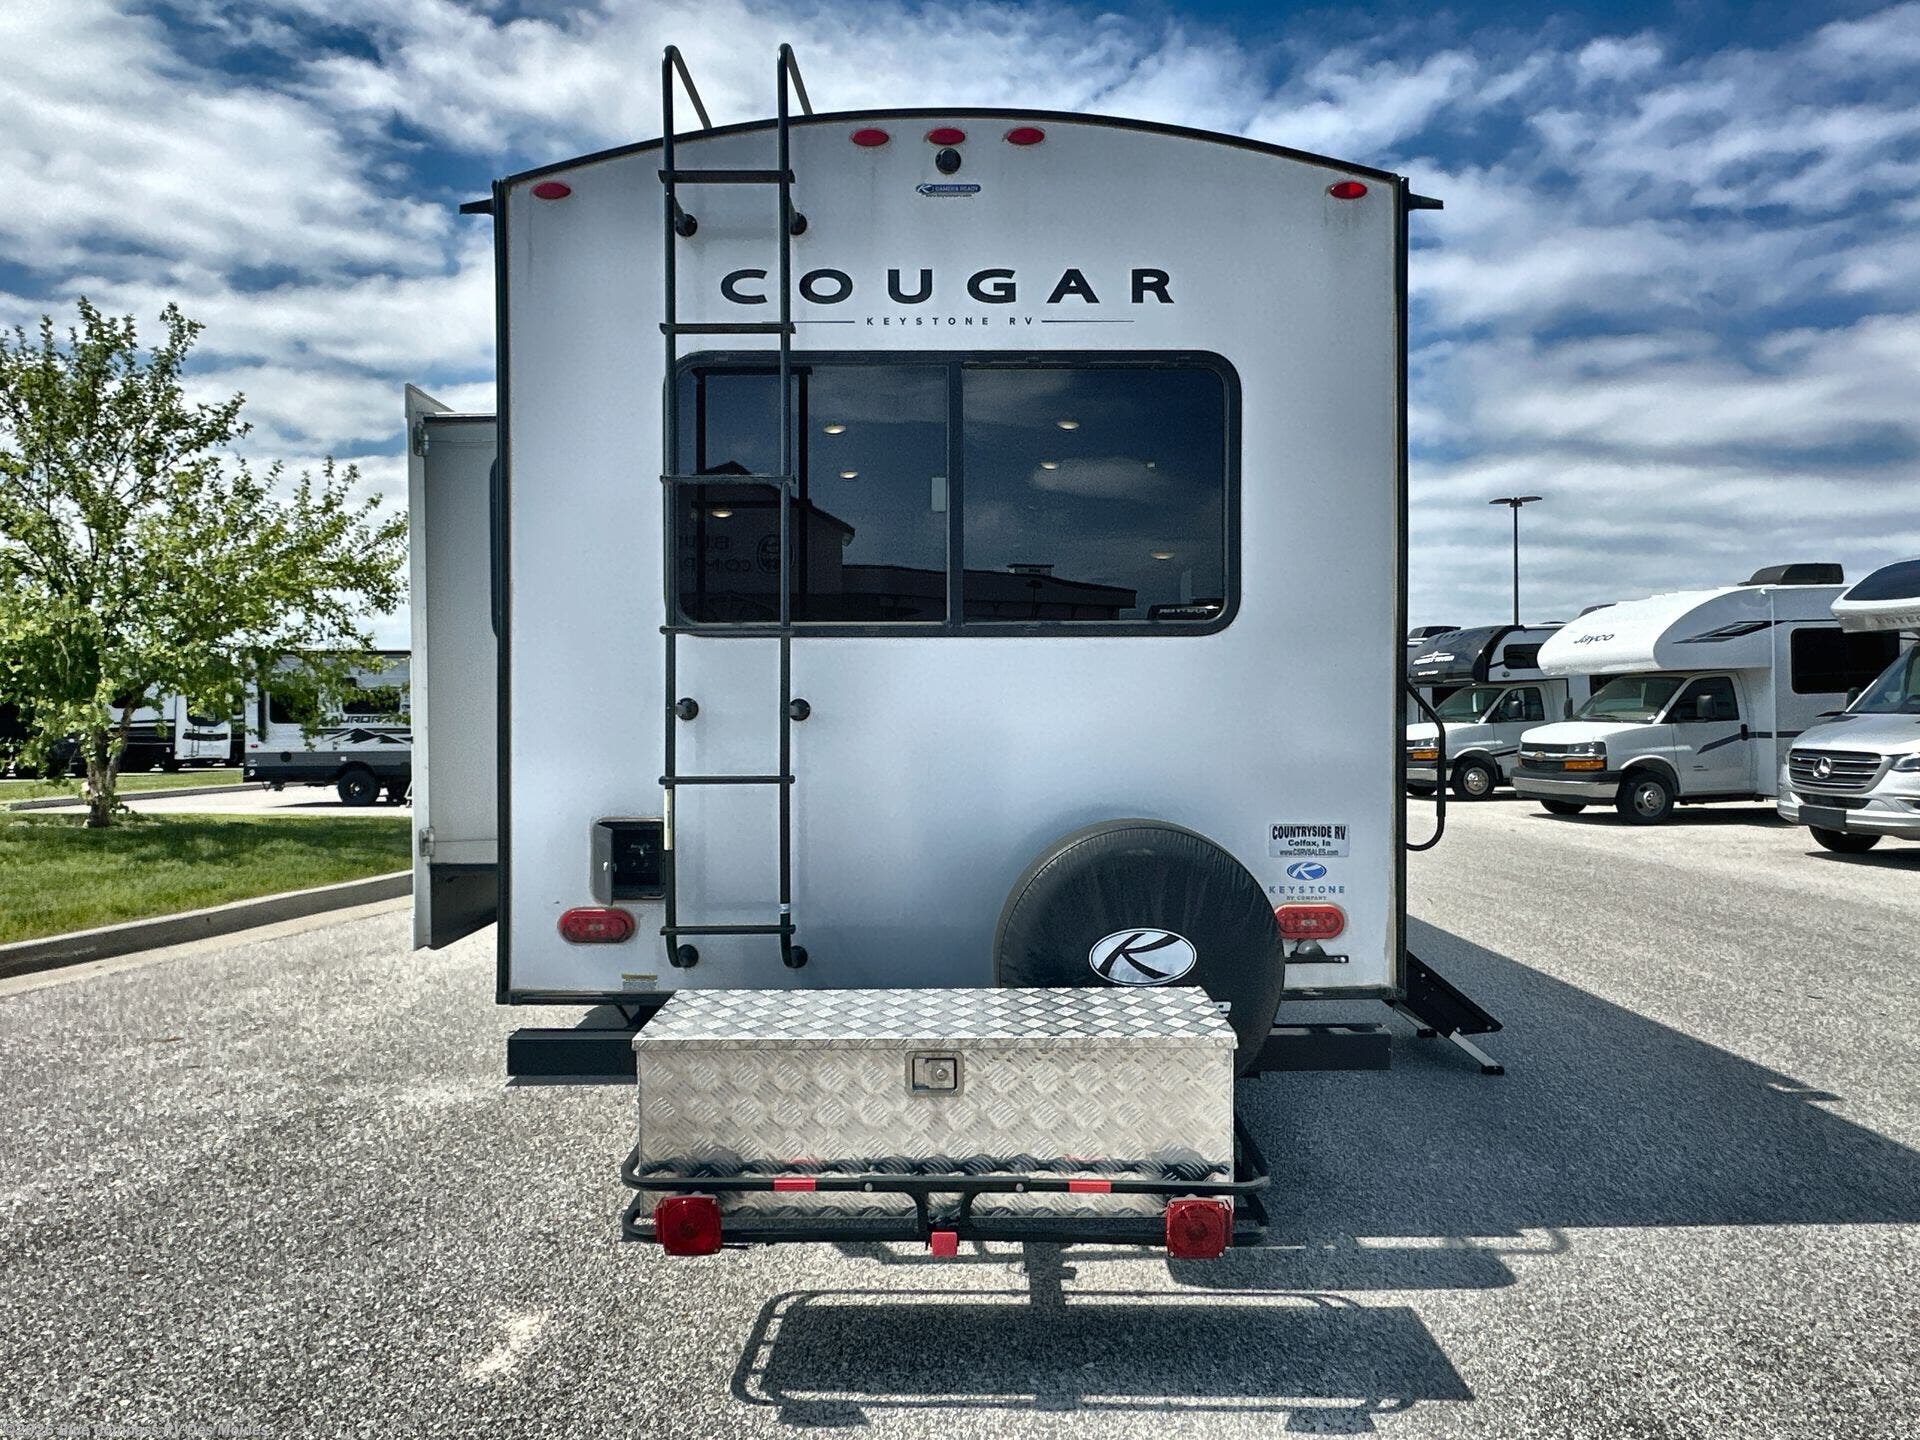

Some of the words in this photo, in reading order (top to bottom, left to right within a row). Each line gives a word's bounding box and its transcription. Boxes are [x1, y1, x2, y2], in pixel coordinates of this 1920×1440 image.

[720, 268, 1175, 304] COUGAR
[866, 317, 990, 326] KEYSTONE
[1009, 317, 1033, 326] RV
[1574, 633, 1615, 645] Jayco
[1272, 825, 1332, 840] COUNTRYSIDE
[1334, 826, 1346, 840] RV
[1288, 839, 1319, 848] Colfax,
[1322, 839, 1331, 847] Ia
[1269, 886, 1345, 894] KEYSTONE
